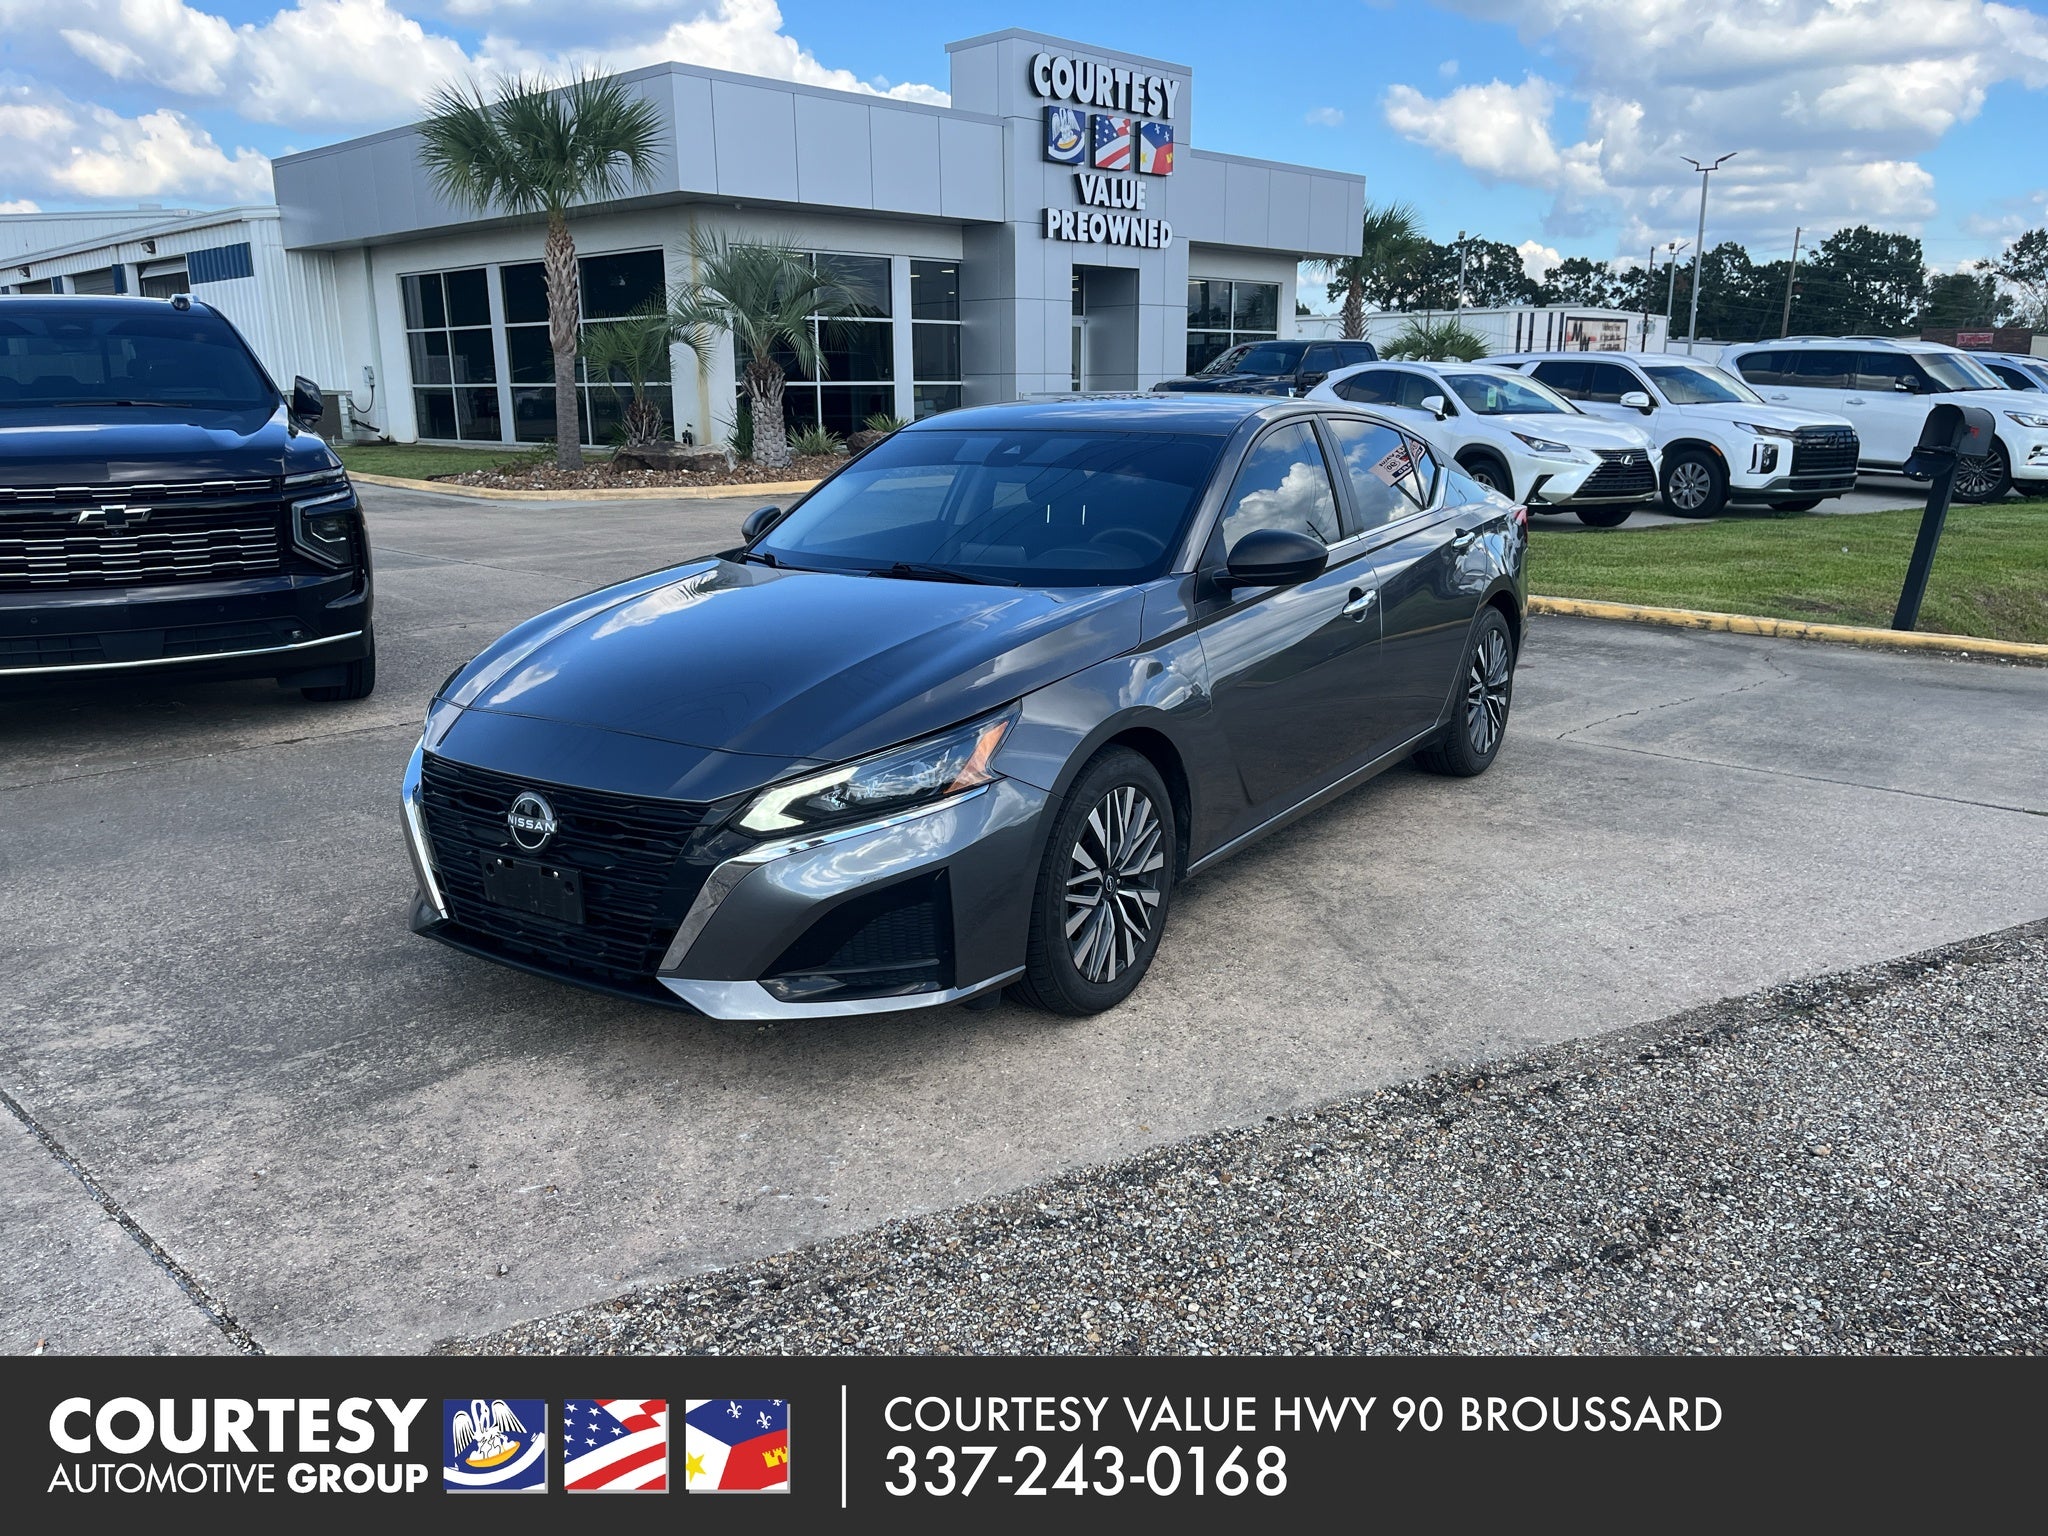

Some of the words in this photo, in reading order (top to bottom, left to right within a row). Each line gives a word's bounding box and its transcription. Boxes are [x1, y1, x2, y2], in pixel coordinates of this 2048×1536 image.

[1030, 52, 1181, 119] COURTESY
[1075, 173, 1146, 210] VALUE
[1043, 207, 1173, 249] PREOWNED
[507, 814, 555, 832] NISSAN
